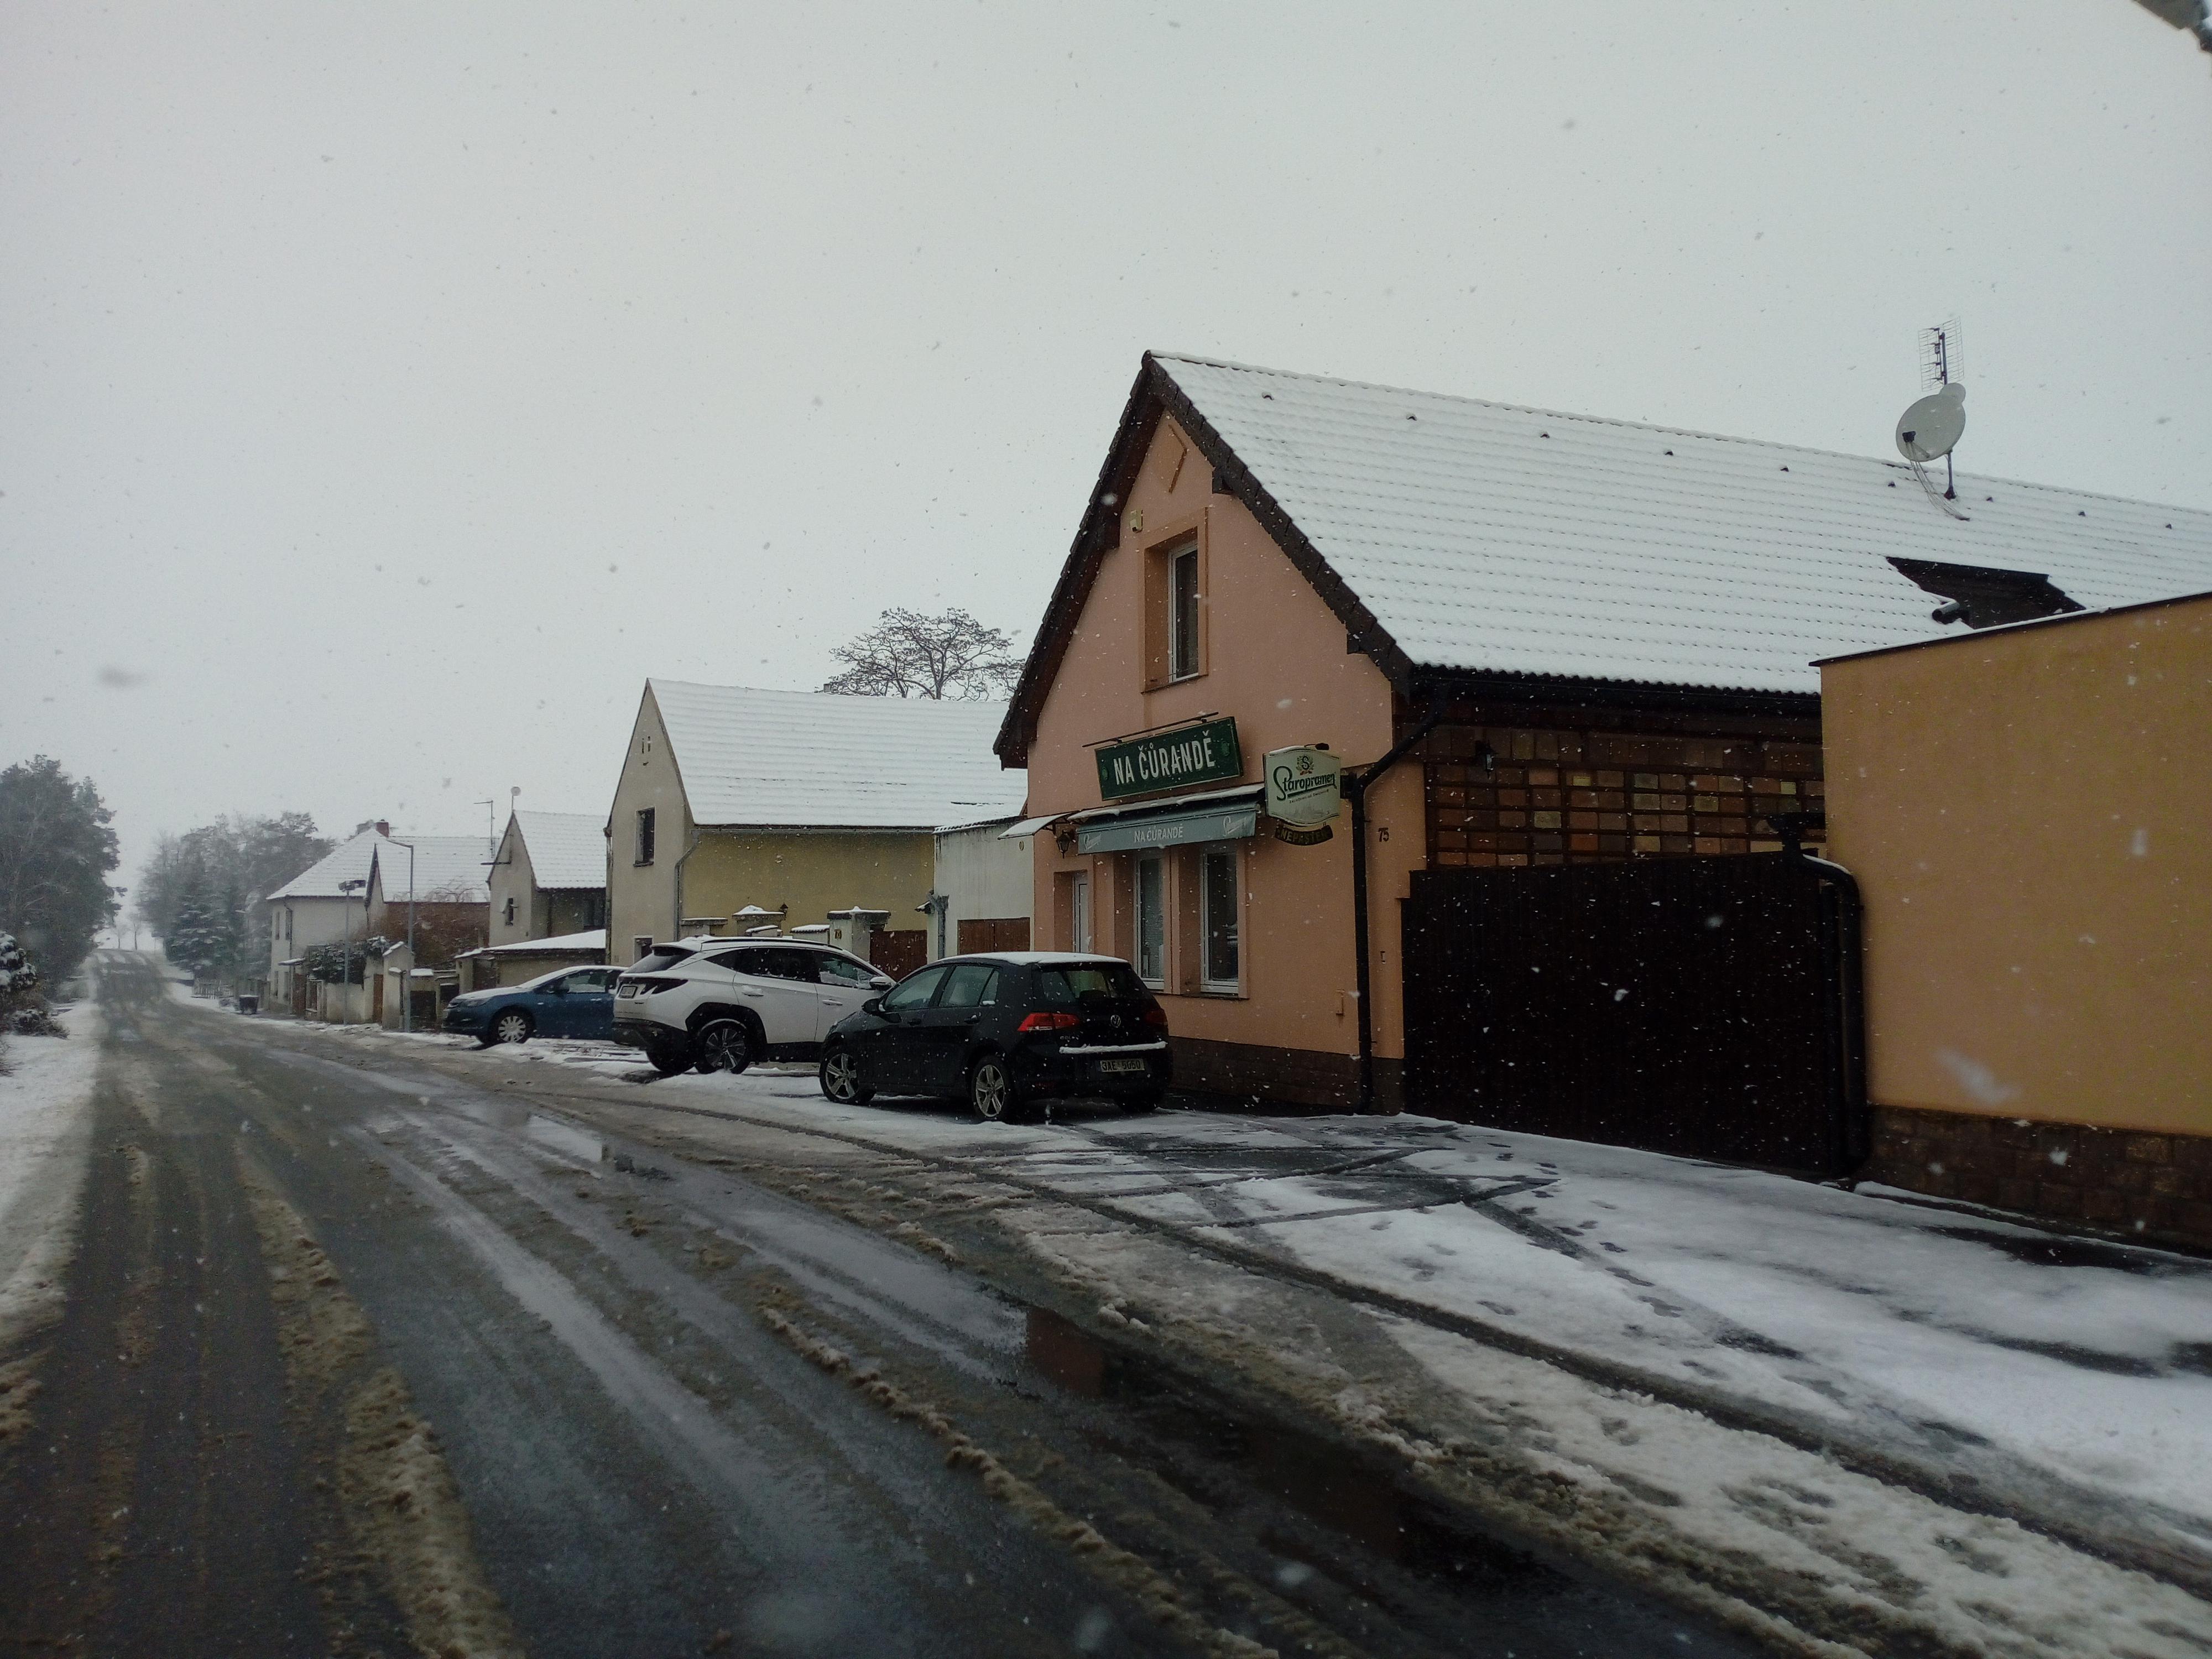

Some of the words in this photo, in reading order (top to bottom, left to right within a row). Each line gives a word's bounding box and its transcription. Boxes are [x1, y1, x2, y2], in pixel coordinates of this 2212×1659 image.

[1113, 755, 1135, 785] NA
[1138, 730, 1215, 780] ČŮRANDĚ
[1302, 755, 1310, 770] S
[1273, 765, 1337, 801] Staropramen
[1134, 830, 1145, 843] NA
[1378, 827, 1389, 842] 75
